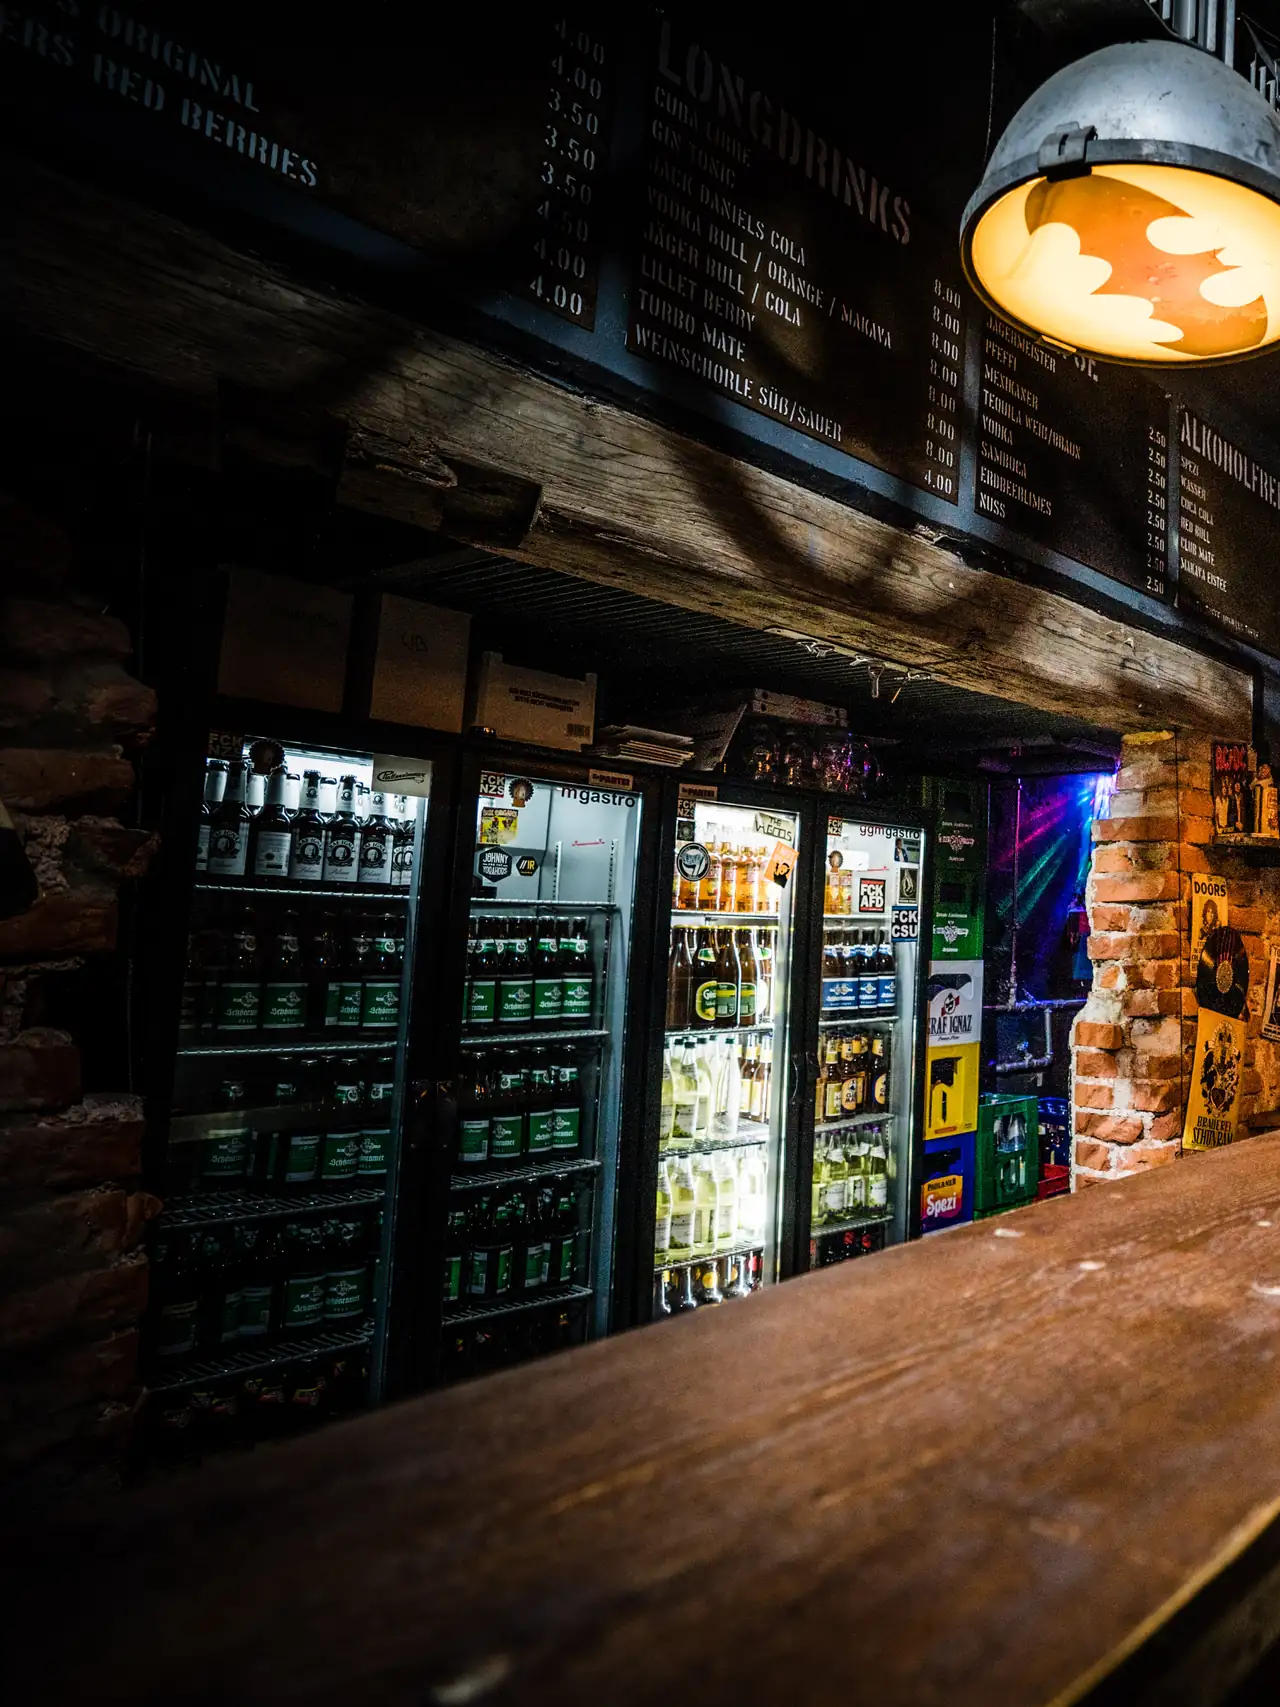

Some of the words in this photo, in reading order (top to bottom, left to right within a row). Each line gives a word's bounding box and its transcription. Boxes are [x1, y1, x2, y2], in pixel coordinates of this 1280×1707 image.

[98, 4, 261, 114] ORIGINAL
[550, 54, 603, 100] 4.00
[93, 52, 166, 112] RED
[181, 97, 319, 188] BERRIES
[548, 87, 599, 135] 3.50
[654, 85, 699, 133] CUBA
[706, 121, 753, 168] LIBRE
[658, 20, 911, 245] LONGDRINKS
[544, 125, 596, 171] 3.50
[652, 118, 681, 150] GIN
[689, 141, 737, 189] TONIC
[540, 160, 593, 206] 3.50
[699, 183, 765, 241] DANIELS
[770, 221, 807, 268] COLA
[533, 238, 588, 279] 4.00
[647, 183, 701, 237] VODKA
[707, 223, 747, 264] BULL
[767, 260, 825, 309] ORANGE
[840, 303, 893, 350] MAKAVA
[530, 274, 583, 316] 4.00
[641, 252, 699, 302] LILLET
[703, 287, 756, 333] BERRY
[705, 253, 745, 296] BULL
[765, 290, 801, 327] COLA
[933, 278, 961, 310] 8.00
[637, 286, 697, 336] TURBO
[702, 322, 746, 363] MATE
[932, 305, 960, 336] 8.00
[634, 323, 753, 400] WEINSCHORLE
[930, 332, 959, 362] 8.00
[985, 338, 1017, 372] PFEFFI
[928, 358, 958, 388] 8.00
[984, 363, 1039, 411] MEXIKANER
[927, 385, 957, 413] 8.00
[983, 388, 1023, 426] TEQUILA
[926, 412, 956, 442] 8.00
[982, 414, 1014, 446] VODKA
[1148, 426, 1167, 448] 2.50
[925, 439, 954, 469] 8.00
[980, 440, 1028, 479] SAMBUCA
[1148, 447, 1166, 469] 2.50
[1180, 411, 1280, 512] ALKOHOLFREI
[1180, 455, 1200, 477] SPEZI
[924, 468, 953, 495] 4.00
[980, 465, 1053, 517] ERDBEERLIMES
[1147, 468, 1166, 490] 2.50
[1180, 474, 1206, 502] WASSER
[979, 491, 1006, 519] NUSS
[1147, 489, 1166, 511] 2.50
[1180, 496, 1197, 516] COCA
[1199, 506, 1214, 526] COLA
[1147, 510, 1166, 531] 2.50
[1180, 516, 1194, 535] RED
[1195, 525, 1211, 544] BULL
[1147, 532, 1165, 553] 2.50
[1180, 536, 1197, 556] CLUB
[1200, 548, 1215, 566] MATE
[1146, 553, 1165, 573] 2.50
[1180, 556, 1207, 582] MAKAVA
[1207, 571, 1229, 593] EISTEE
[1145, 576, 1164, 595] 2.50
[208, 732, 245, 747] FCK
[479, 783, 505, 795] NZS
[480, 774, 505, 785] FCK
[677, 808, 696, 817] NZS
[678, 799, 696, 809] FCK
[769, 815, 783, 826] THE
[827, 827, 842, 835] NZS
[828, 820, 843, 828] FCK
[482, 852, 509, 864] JOHNNY
[860, 883, 884, 896] FCK
[860, 895, 884, 908] AFD
[1194, 881, 1226, 897] DOORS
[891, 910, 918, 923] FCK
[891, 924, 918, 938] CSU
[949, 1014, 973, 1034] IGNAZ
[927, 1178, 956, 1192] PAULANER
[926, 1192, 957, 1218] Spezi
